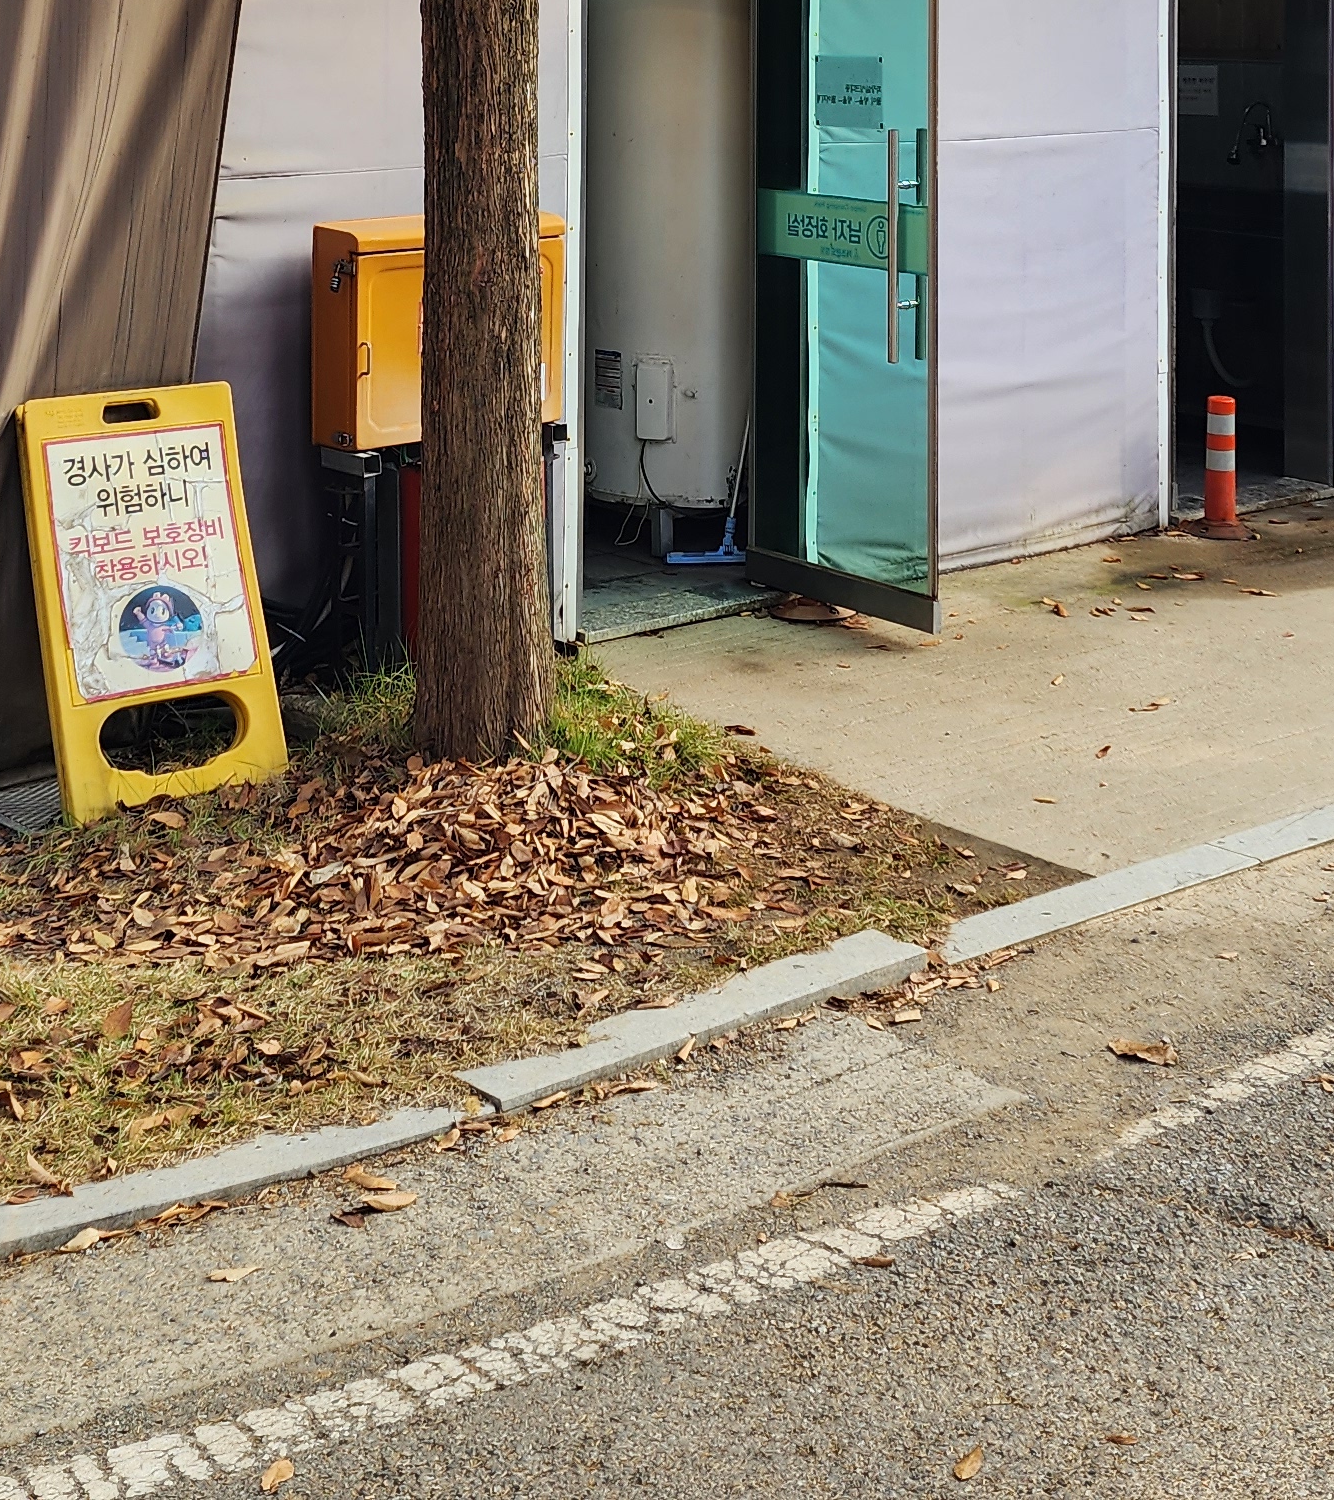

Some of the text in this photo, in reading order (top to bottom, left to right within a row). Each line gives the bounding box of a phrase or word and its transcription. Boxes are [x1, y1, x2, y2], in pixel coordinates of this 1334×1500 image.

[63, 442, 212, 487] 경사가 심하여
[96, 479, 190, 518] 위험하니
[69, 517, 225, 558] 킥보드 보호장비
[95, 545, 209, 583] 착용하시오!
